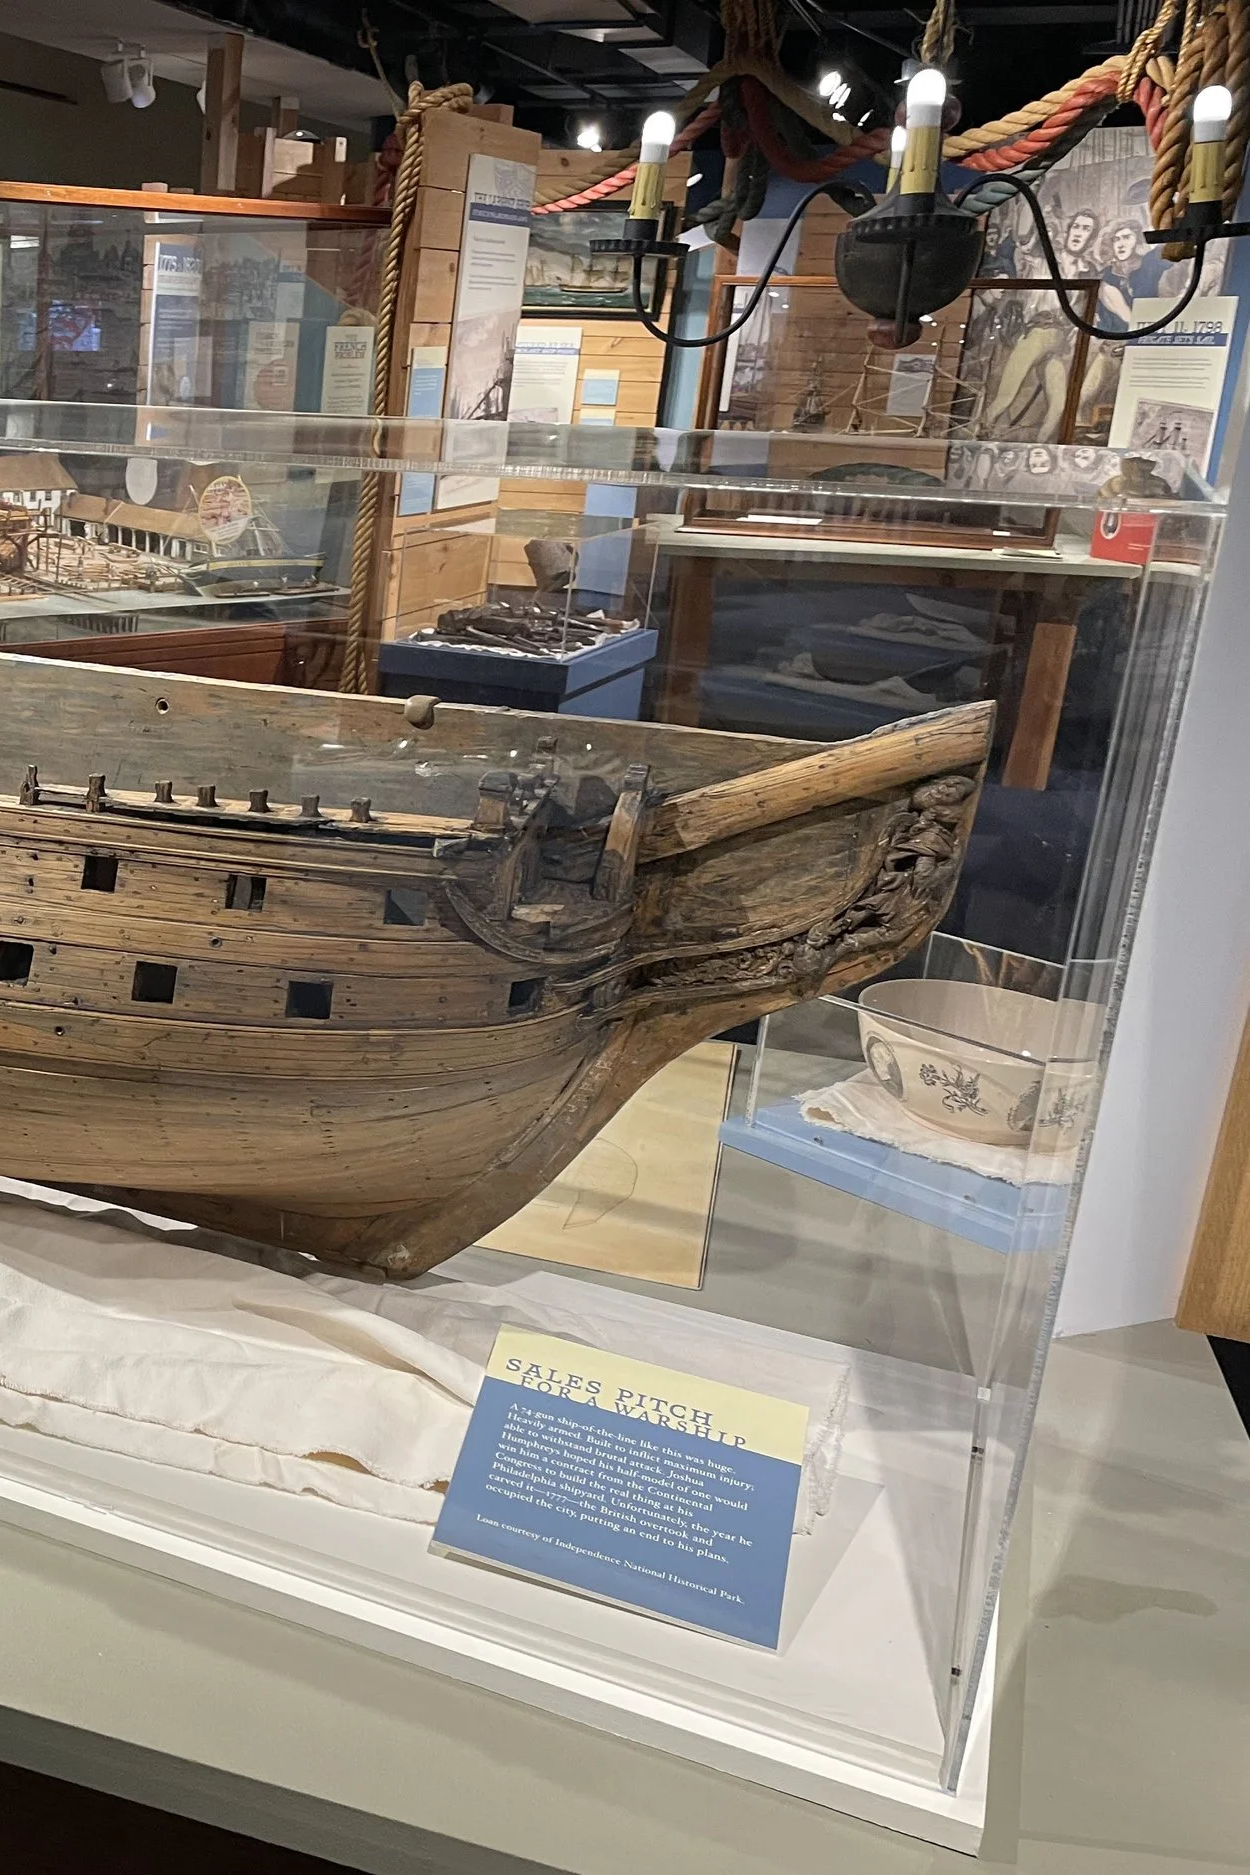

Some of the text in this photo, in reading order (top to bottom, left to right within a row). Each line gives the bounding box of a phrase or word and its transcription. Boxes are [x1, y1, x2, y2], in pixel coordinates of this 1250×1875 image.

[1194, 321, 1223, 333] 1798
[506, 1359, 713, 1427] SALES PITCH
[521, 1375, 746, 1447] FOR A WARSHIP
[502, 1431, 748, 1511] Humphreys hoped his half-model of one would
[504, 1422, 704, 1486] able to withstand brutal attack. Joshua
[507, 1412, 716, 1479] Heavily armed. Built to inflict maximum
[521, 1407, 554, 1421] 74-gun
[557, 1417, 637, 1445] ship-of-the-line
[640, 1439, 659, 1452] like
[662, 1447, 682, 1458] this
[685, 1454, 704, 1465] was
[708, 1459, 736, 1474] huge.
[489, 1473, 524, 1488] carved
[600, 1505, 637, 1523] British
[639, 1518, 689, 1539] overtook
[692, 1536, 713, 1547] and
[492, 1461, 753, 1547] Philadelphia shipyard. Unfortunately, the year he
[495, 1451, 694, 1517] Congress to build the real thing at his
[498, 1443, 516, 1453] win
[519, 1447, 539, 1460] him
[551, 1459, 595, 1476] contract
[598, 1471, 623, 1486] from
[627, 1480, 644, 1491] the
[648, 1486, 713, 1511] Continental
[486, 1484, 729, 1564] occupied the city, putting an end to his plans.
[476, 1514, 745, 1604] Loan courtesy of Independence National Historical Park.
